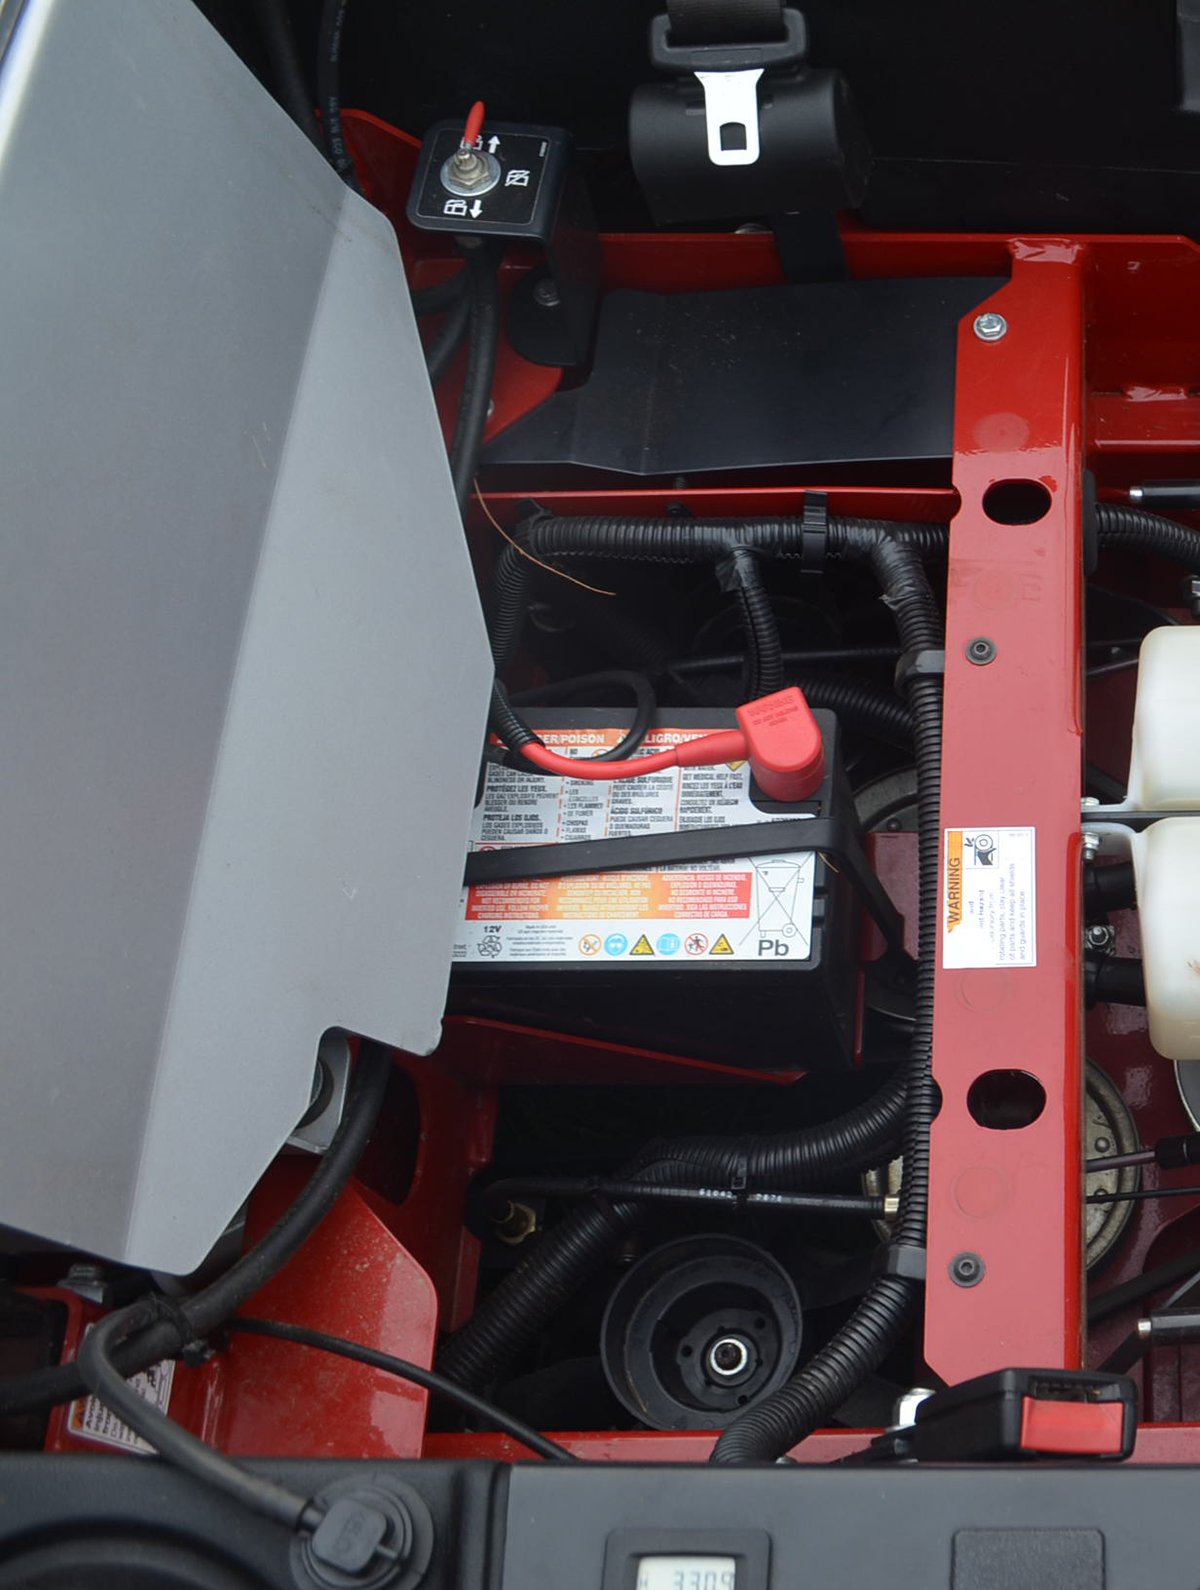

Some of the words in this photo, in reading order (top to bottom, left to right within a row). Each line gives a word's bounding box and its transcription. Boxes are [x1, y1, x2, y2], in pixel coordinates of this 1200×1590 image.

[947, 856, 961, 922] WARNING
[484, 925, 502, 933] 12V
[758, 939, 789, 957] Pb
